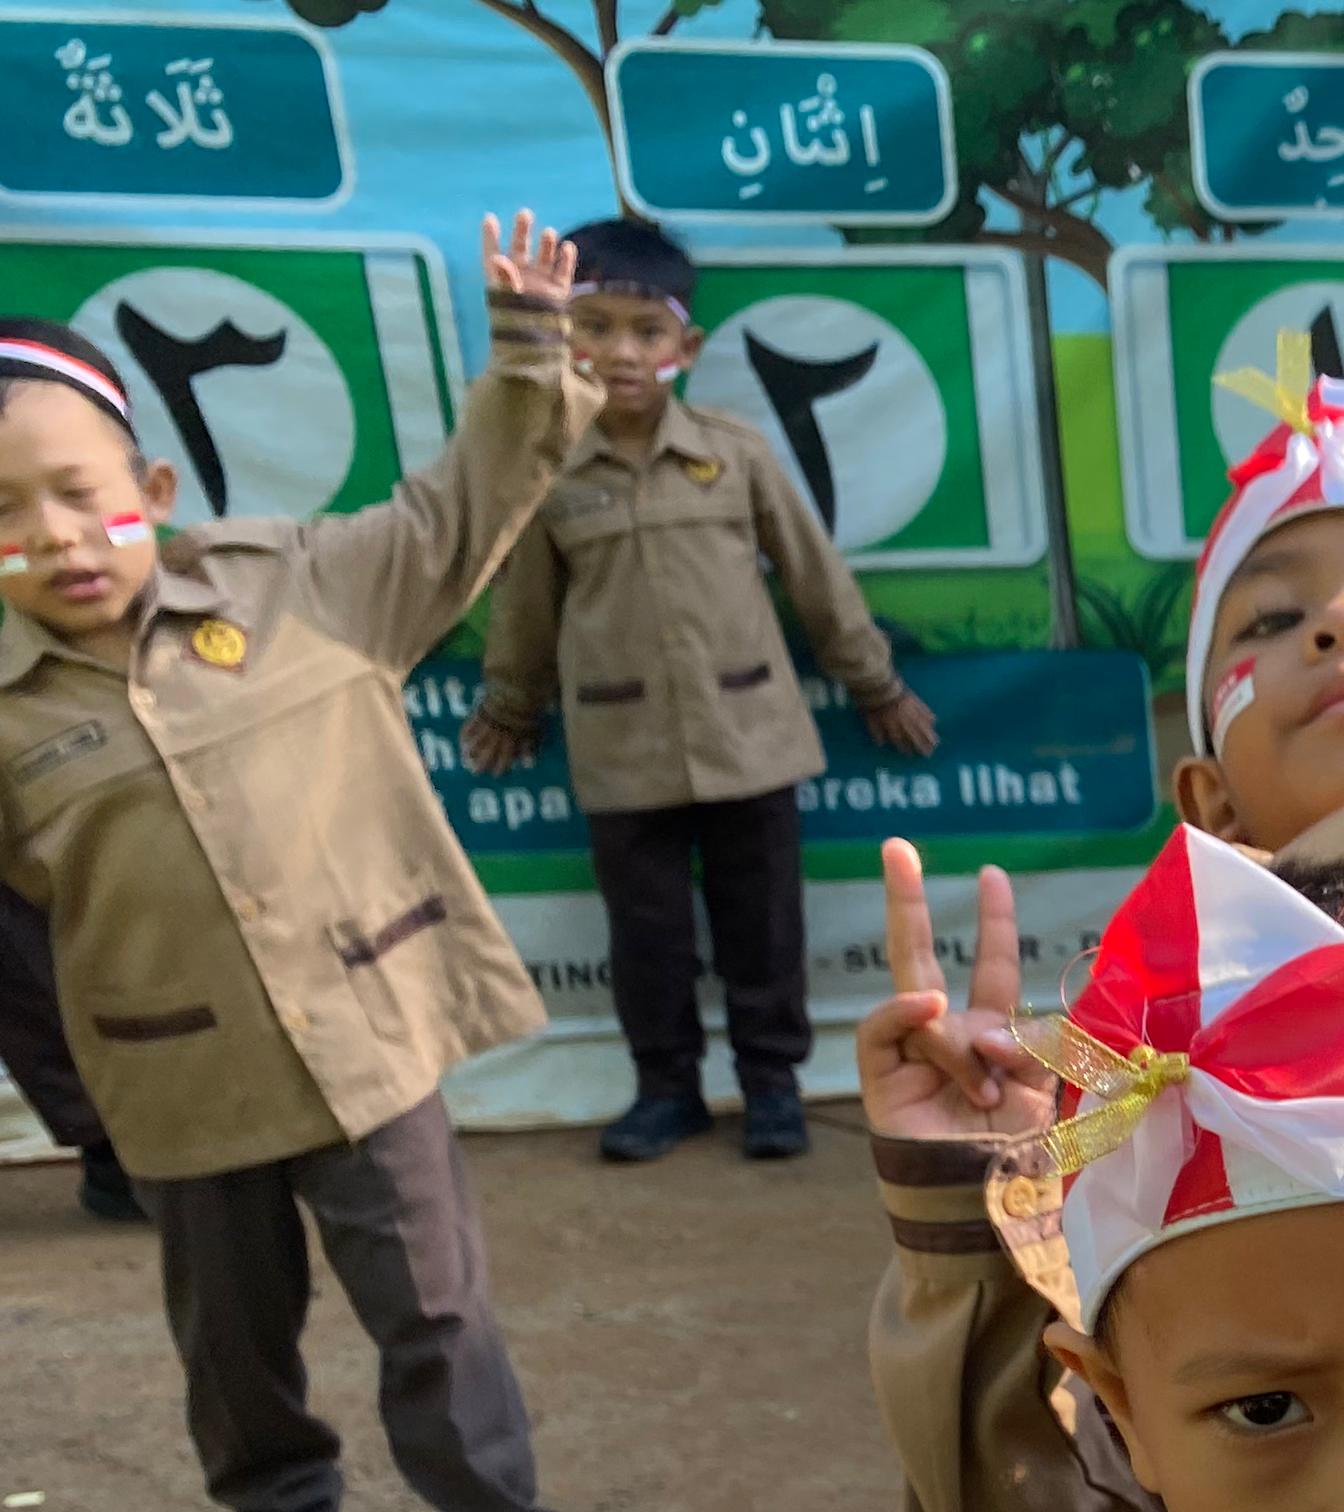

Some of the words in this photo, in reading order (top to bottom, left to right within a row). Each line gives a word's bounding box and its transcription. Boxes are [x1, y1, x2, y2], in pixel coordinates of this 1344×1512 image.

[468, 785, 572, 831] apa
[794, 765, 941, 813] ereka
[957, 760, 1082, 808] lihat
